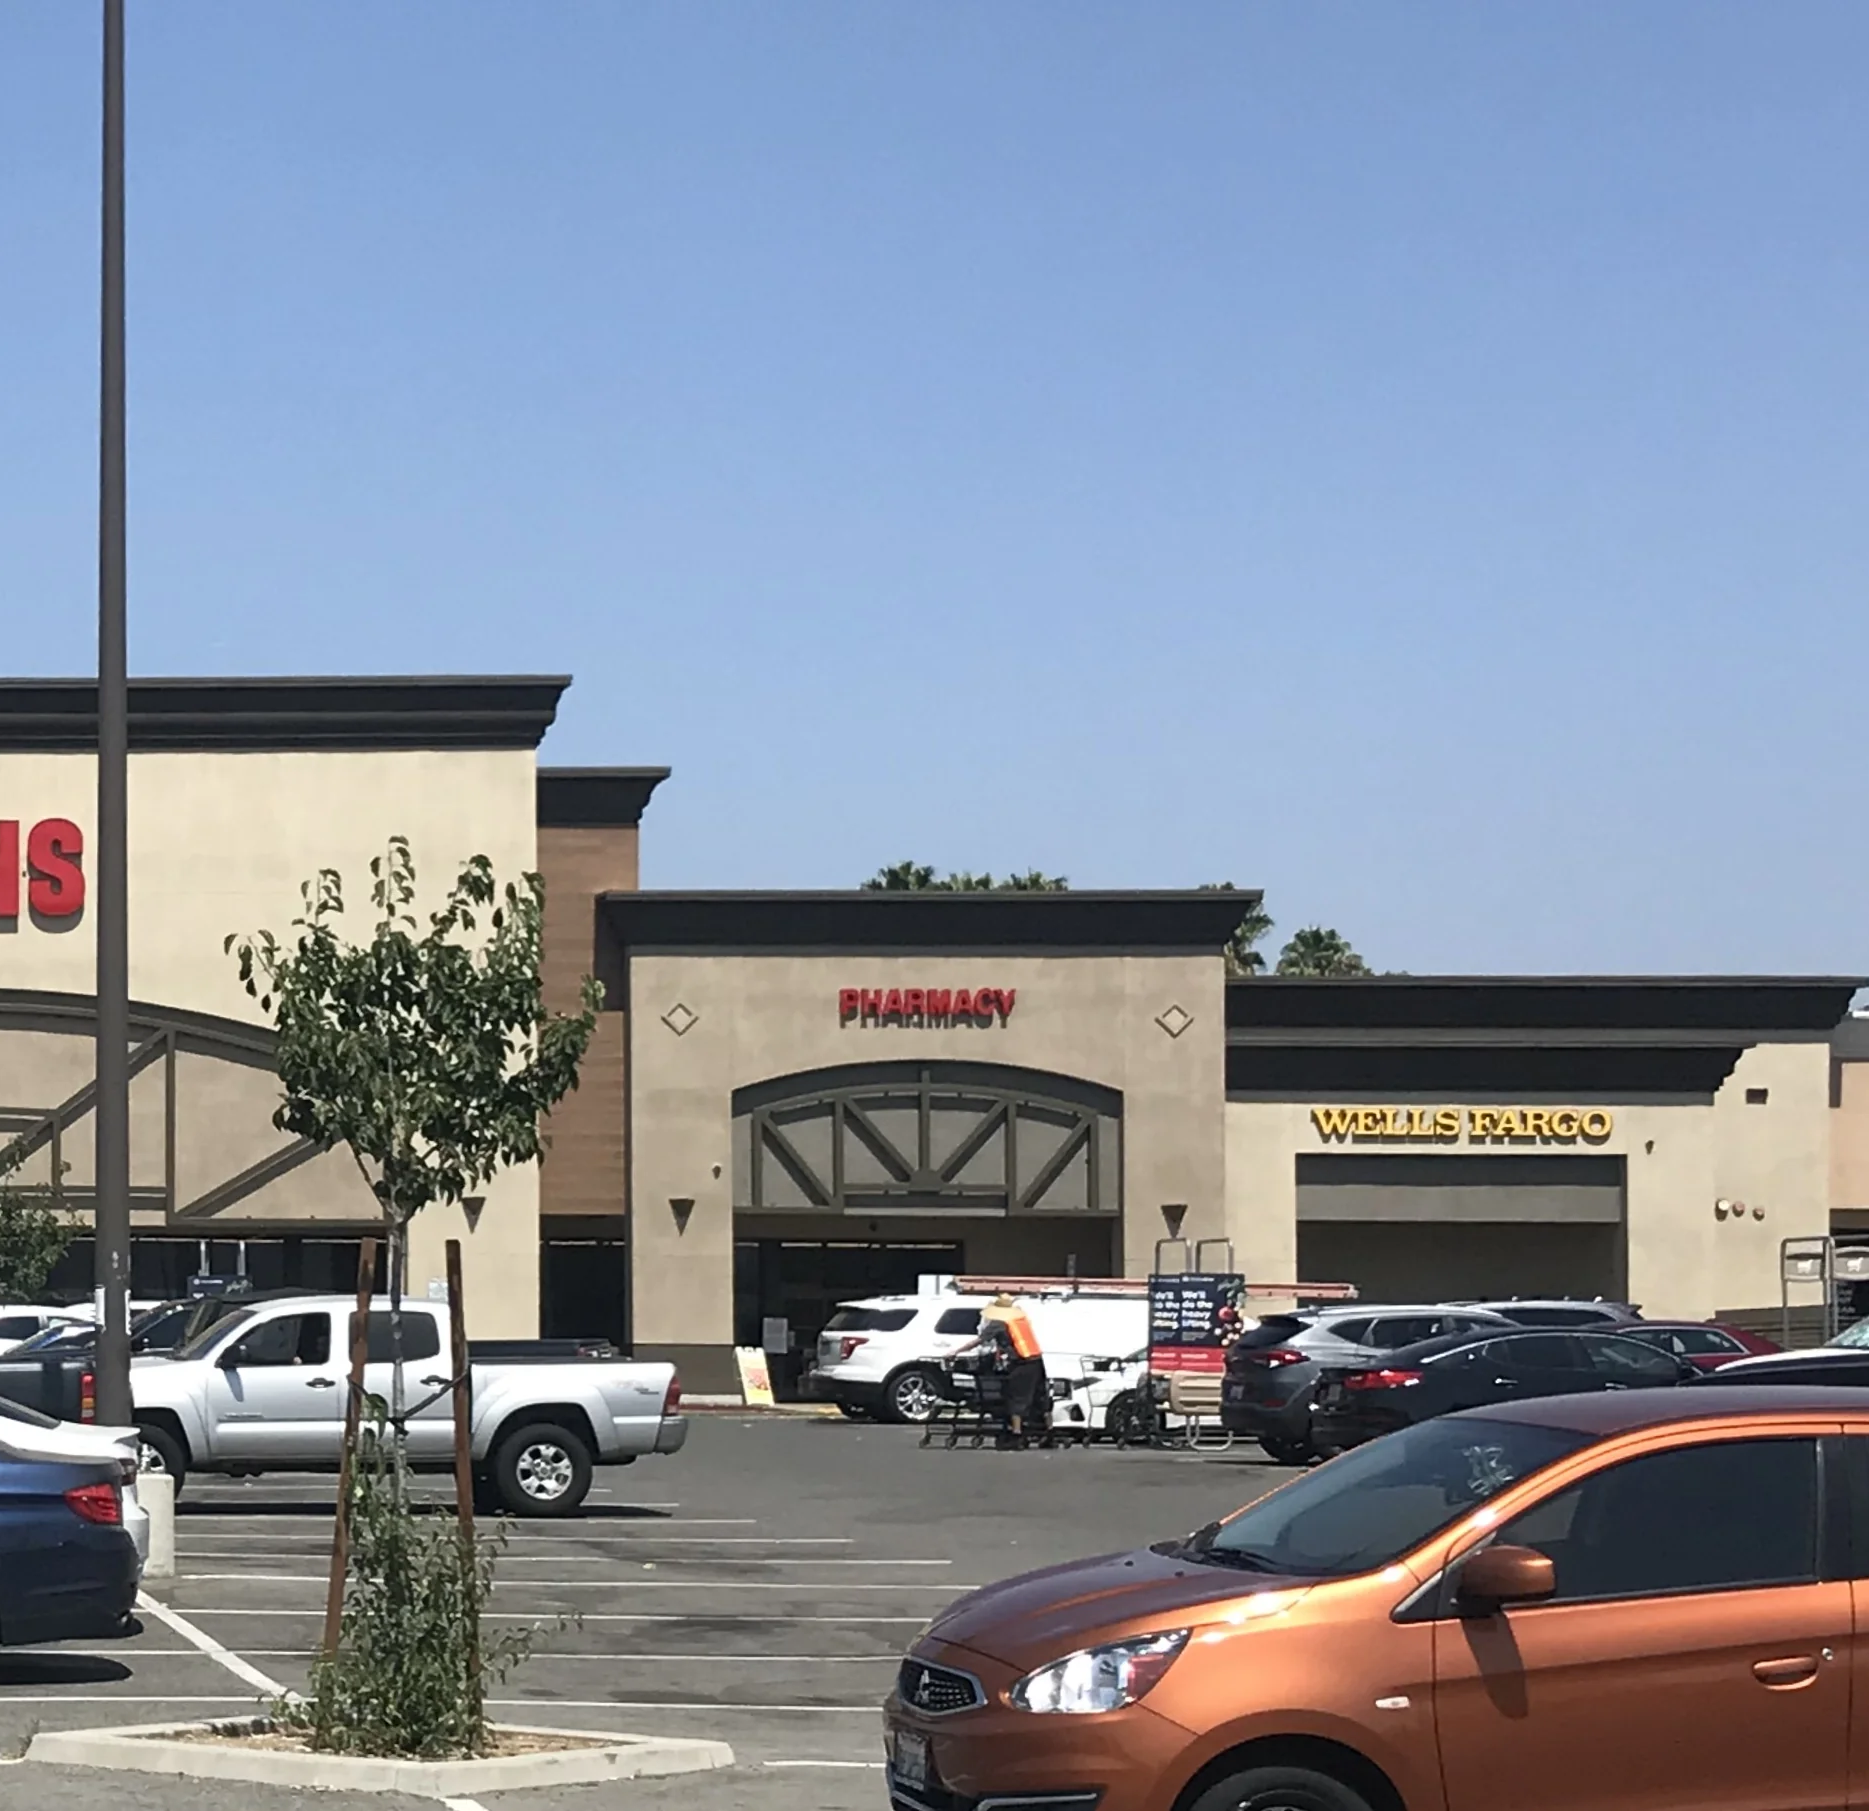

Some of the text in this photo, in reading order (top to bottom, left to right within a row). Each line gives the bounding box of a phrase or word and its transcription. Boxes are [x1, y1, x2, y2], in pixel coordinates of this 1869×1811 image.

[839, 988, 1016, 1017] PHARMACY
[1312, 1107, 1614, 1138] WELLS FARGO
